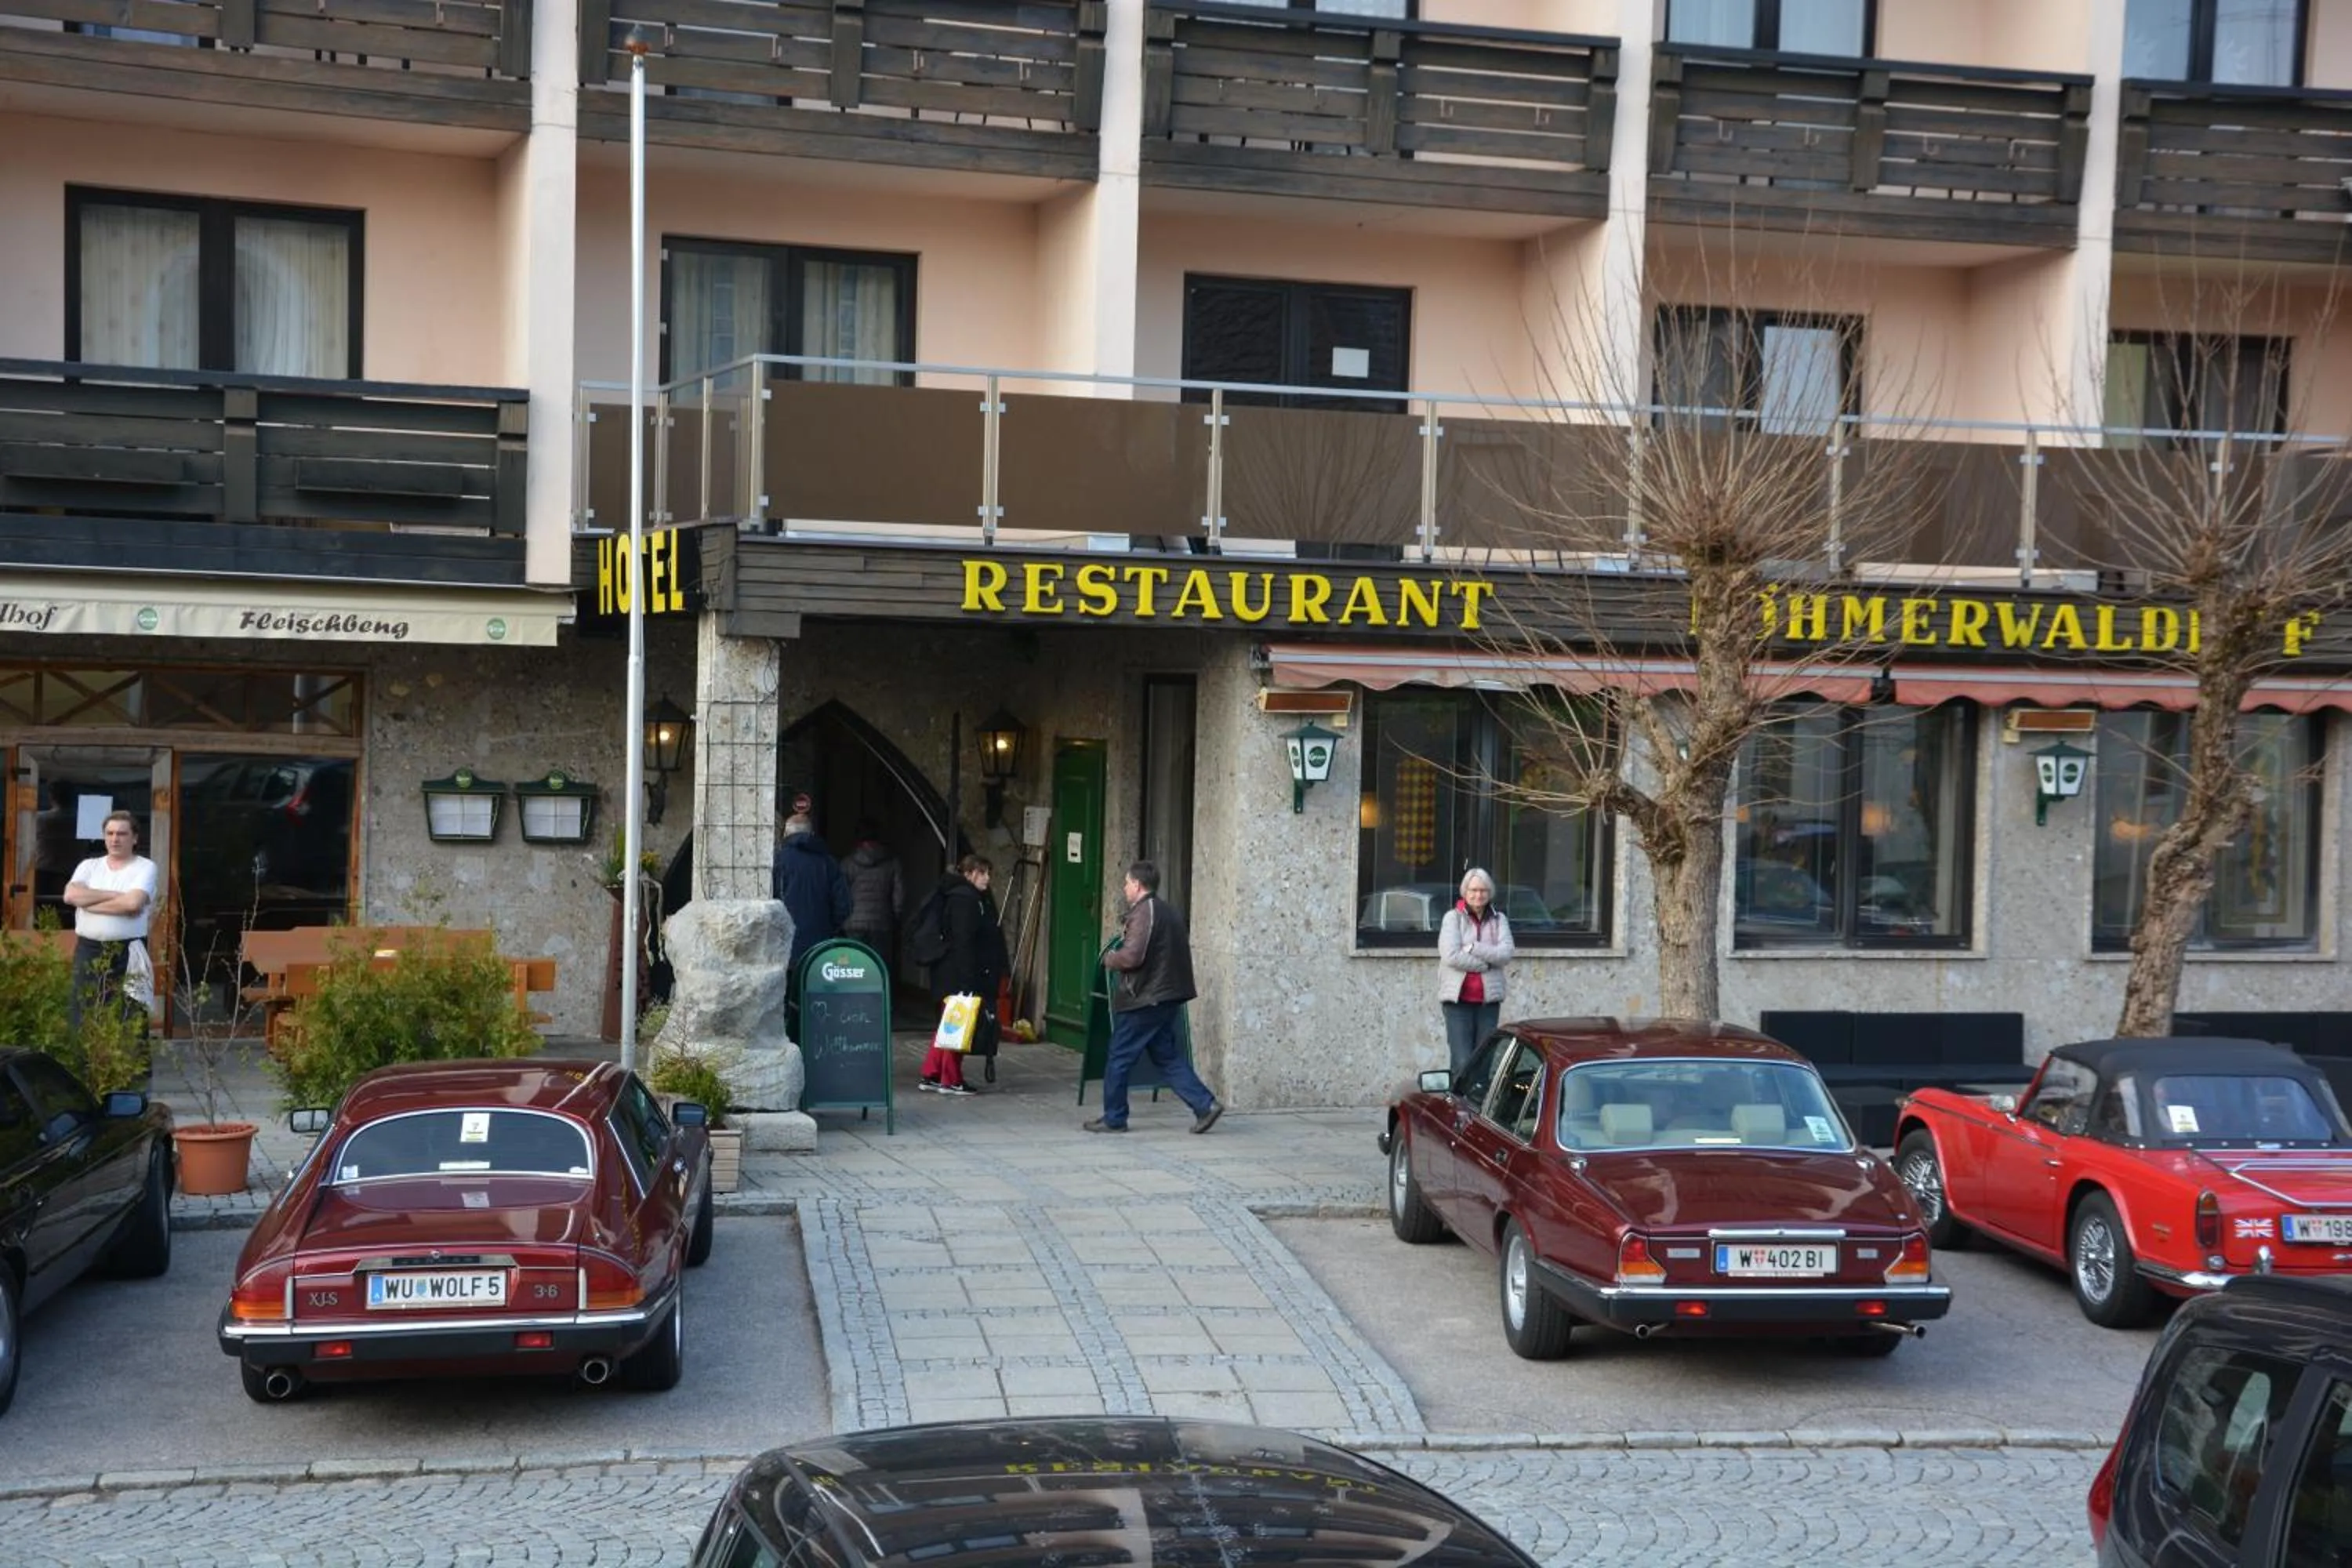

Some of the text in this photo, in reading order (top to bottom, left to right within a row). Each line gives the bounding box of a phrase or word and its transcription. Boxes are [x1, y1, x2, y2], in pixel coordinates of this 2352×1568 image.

[961, 559, 1494, 630] RESTAURANT
[1740, 1250, 1751, 1268] W
[385, 1276, 500, 1298] WU WOLF 5
